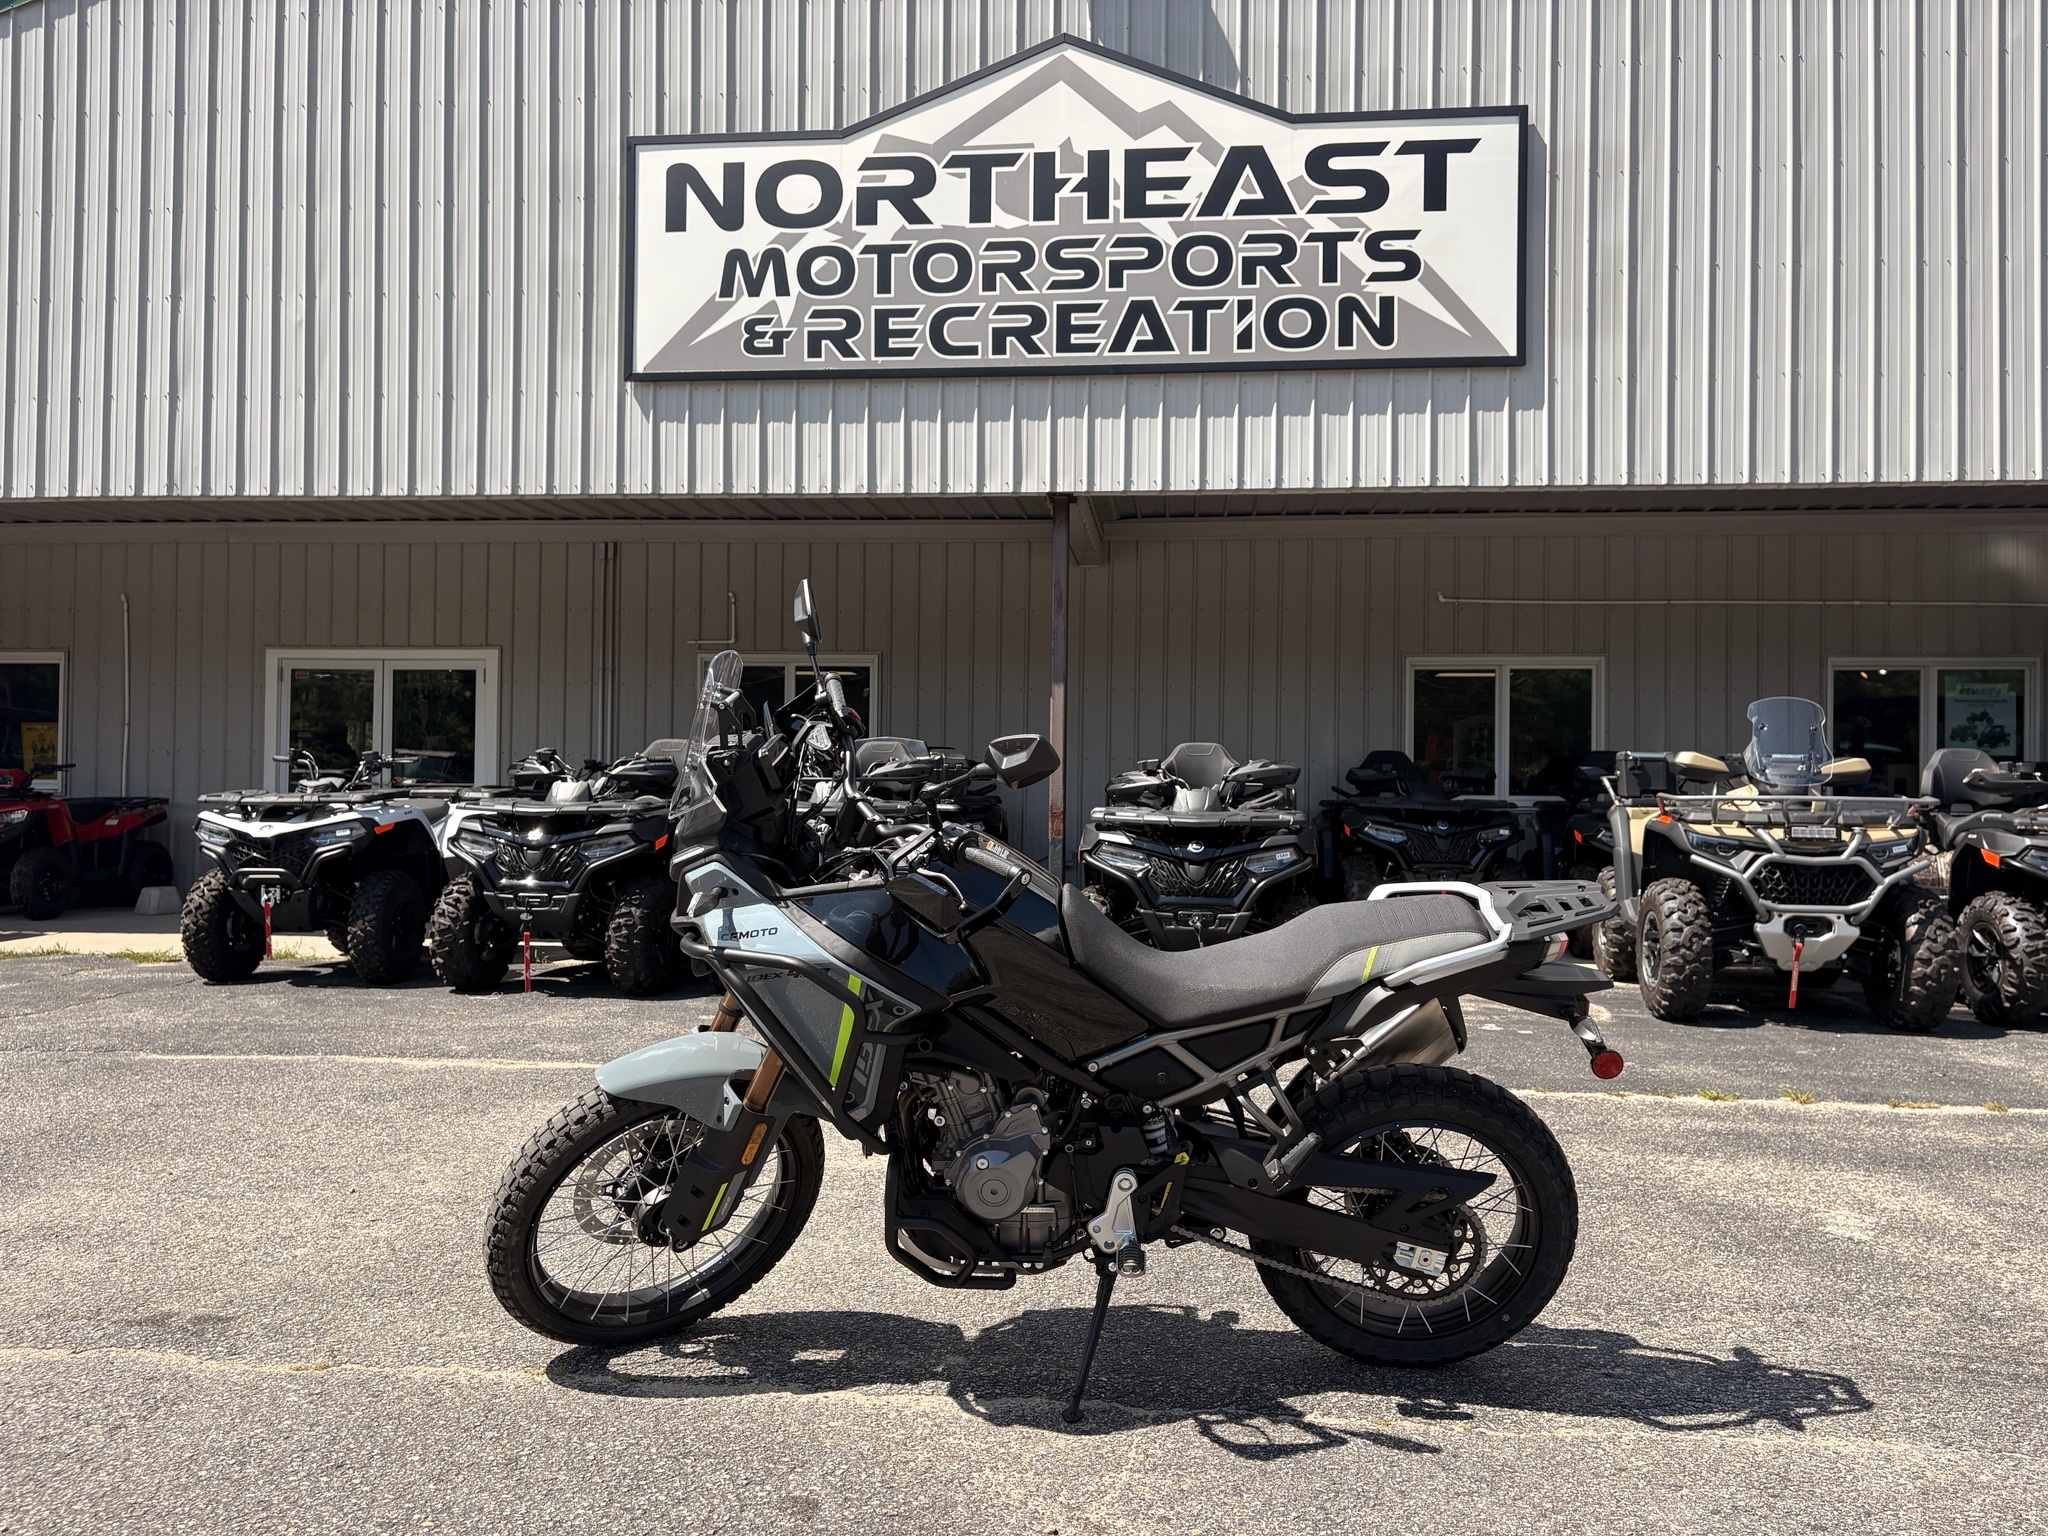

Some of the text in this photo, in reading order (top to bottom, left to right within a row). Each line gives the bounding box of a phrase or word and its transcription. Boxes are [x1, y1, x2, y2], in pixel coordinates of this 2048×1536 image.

[665, 138, 1482, 233] NORTHEAST
[718, 229, 1423, 298] MOTORSPORTS
[806, 295, 1396, 359] RECREATION
[721, 927, 778, 941] CFMOTO
